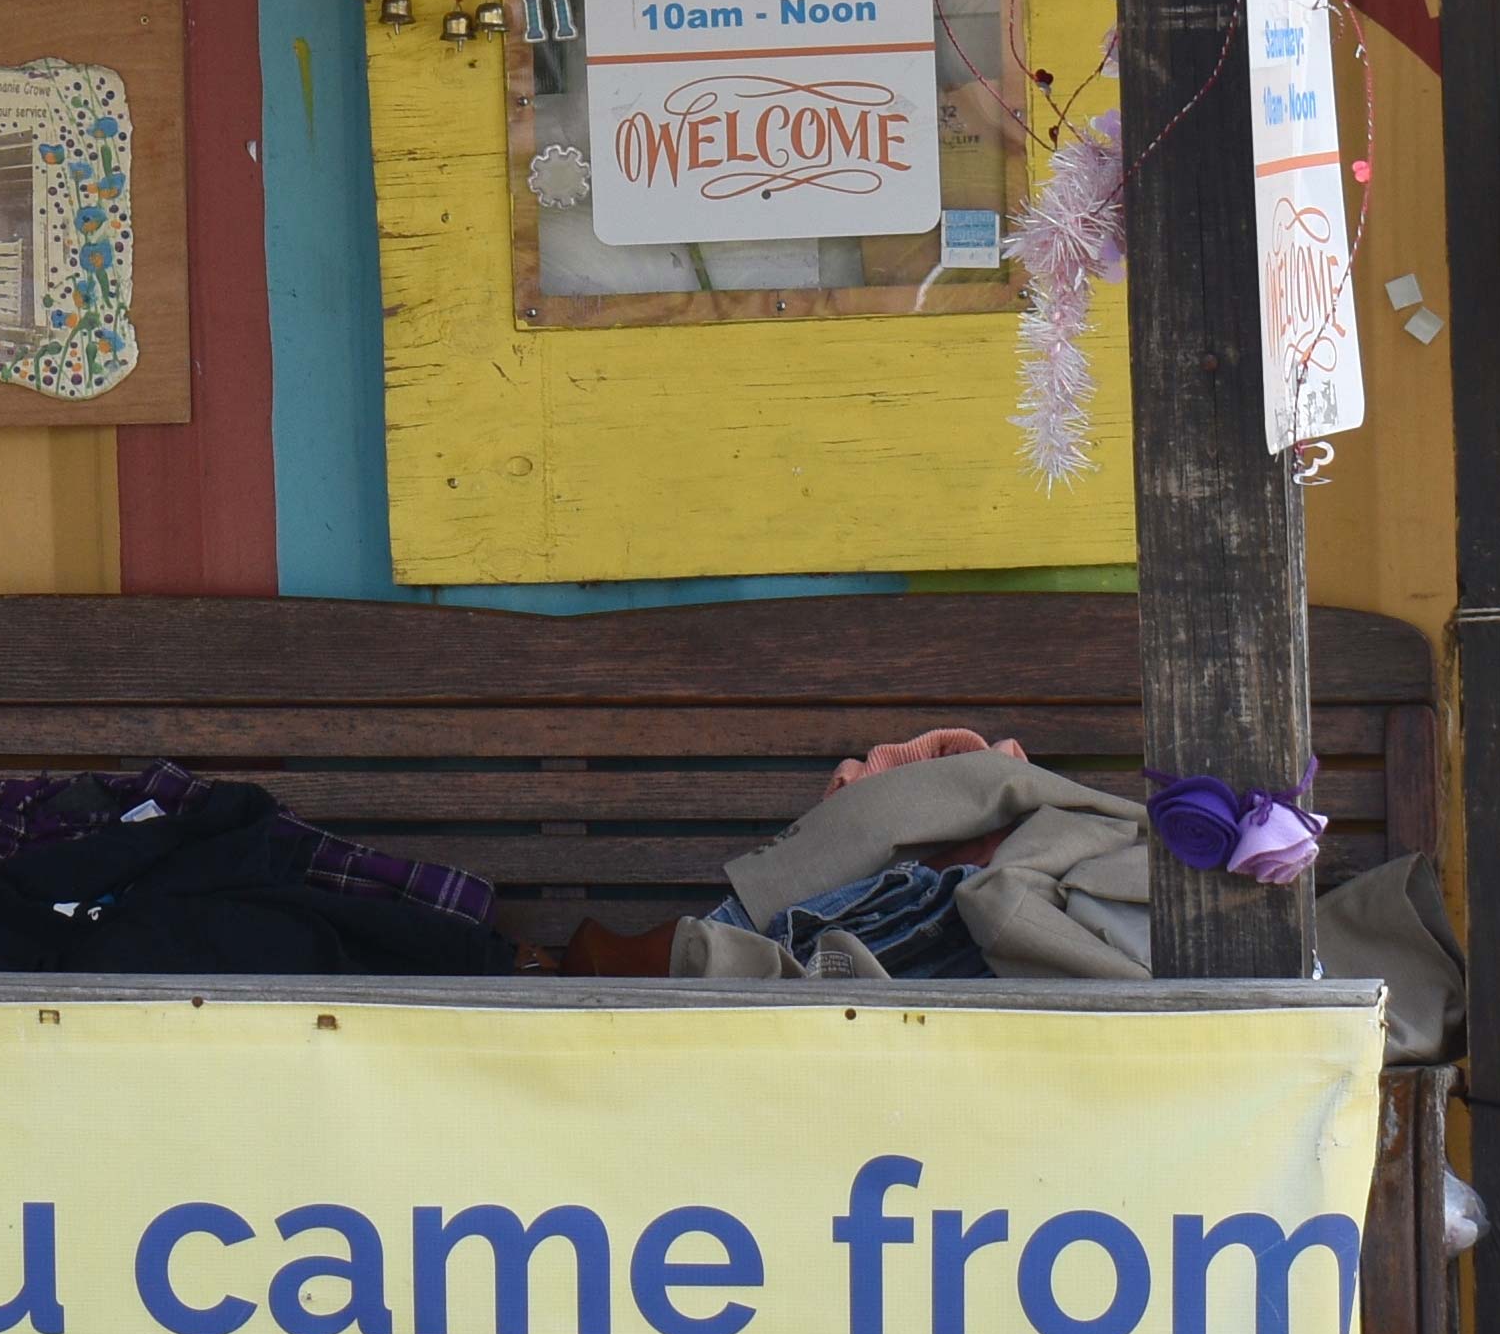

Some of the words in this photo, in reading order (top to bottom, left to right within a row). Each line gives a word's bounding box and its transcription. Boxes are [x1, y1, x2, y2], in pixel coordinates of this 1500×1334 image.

[642, 3, 743, 31] 10am
[15, 104, 47, 118] service
[615, 104, 911, 188] WELCOME
